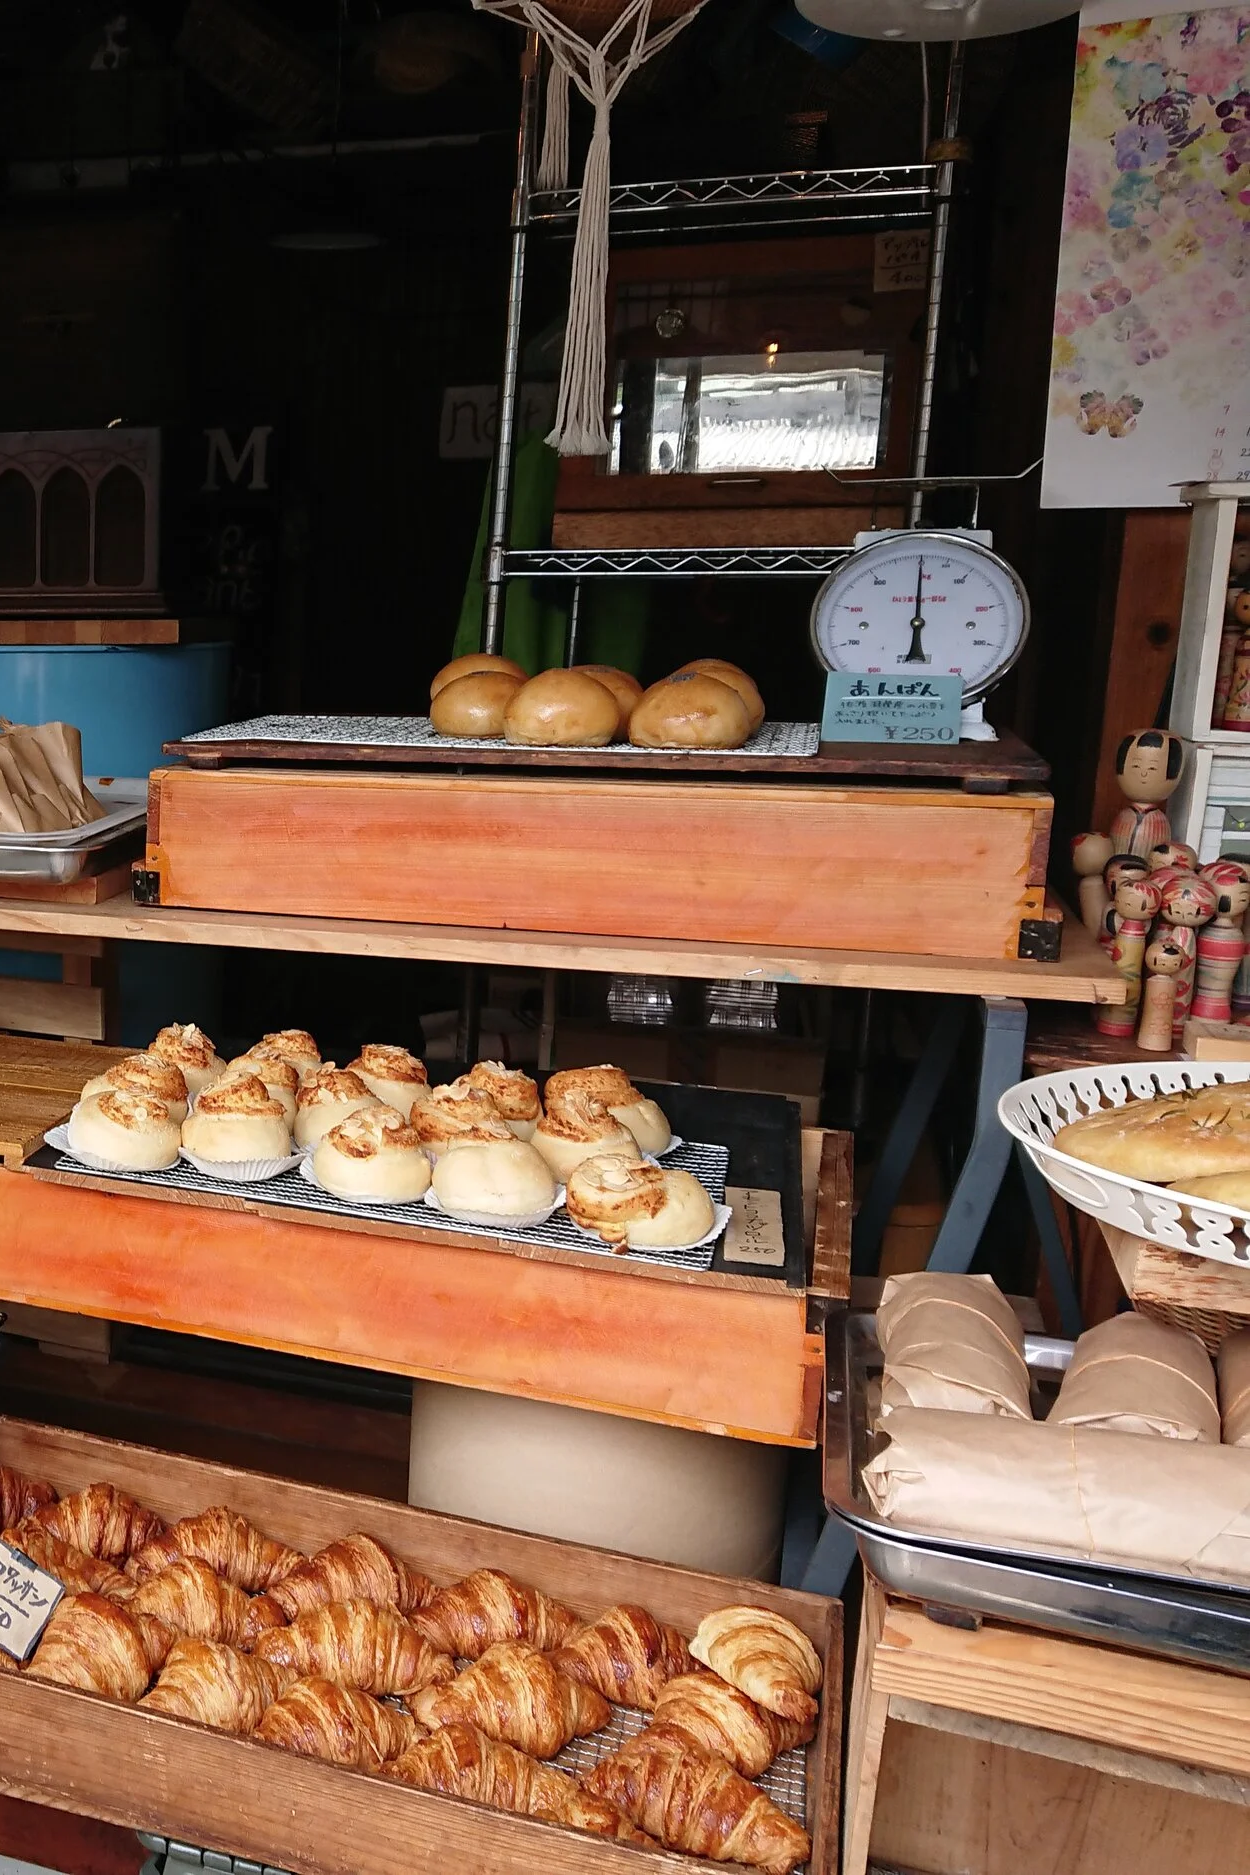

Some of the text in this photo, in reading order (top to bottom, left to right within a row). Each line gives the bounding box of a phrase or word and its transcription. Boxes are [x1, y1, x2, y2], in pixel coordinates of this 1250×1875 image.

[1223, 404, 1231, 415] 7
[1215, 427, 1226, 437] 14
[200, 425, 274, 491] M
[850, 679, 940, 697] あんぱん
[884, 725, 955, 741] ¥250
